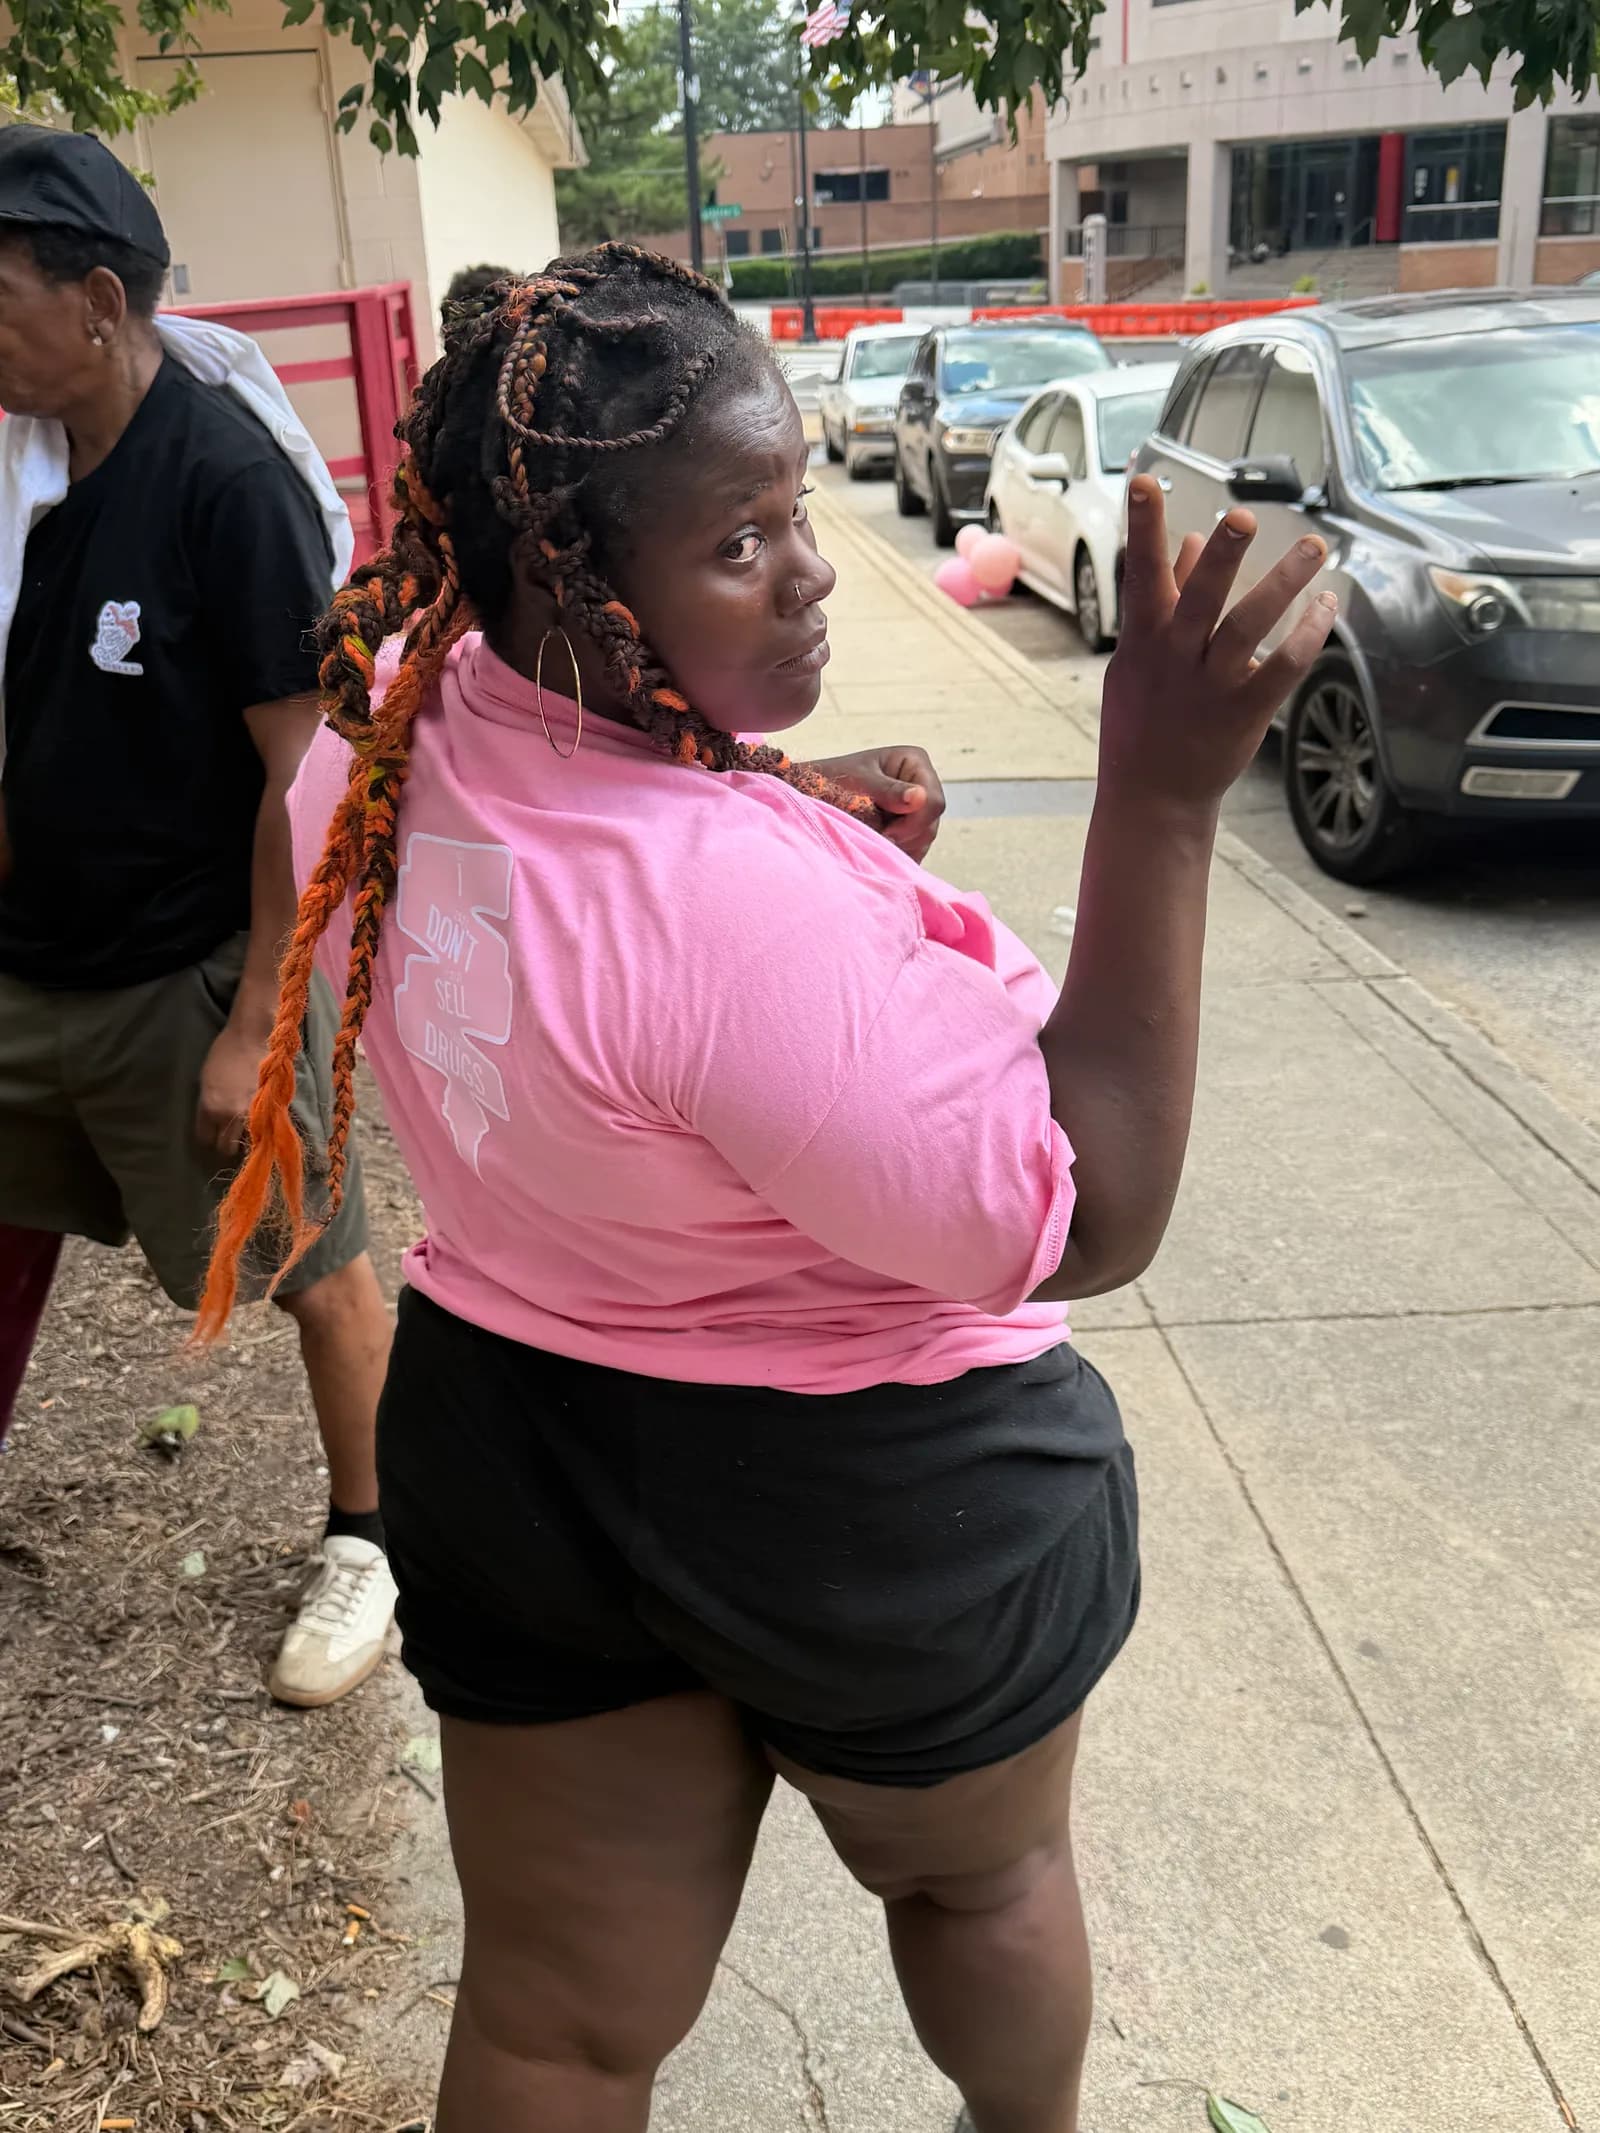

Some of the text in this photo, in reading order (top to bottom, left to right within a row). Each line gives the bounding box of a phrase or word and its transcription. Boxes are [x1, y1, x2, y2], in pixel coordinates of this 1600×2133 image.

[457, 863, 462, 897] I
[426, 903, 479, 973] DON'T
[435, 978, 472, 1020] SELL
[424, 1020, 486, 1097] DRUGS
